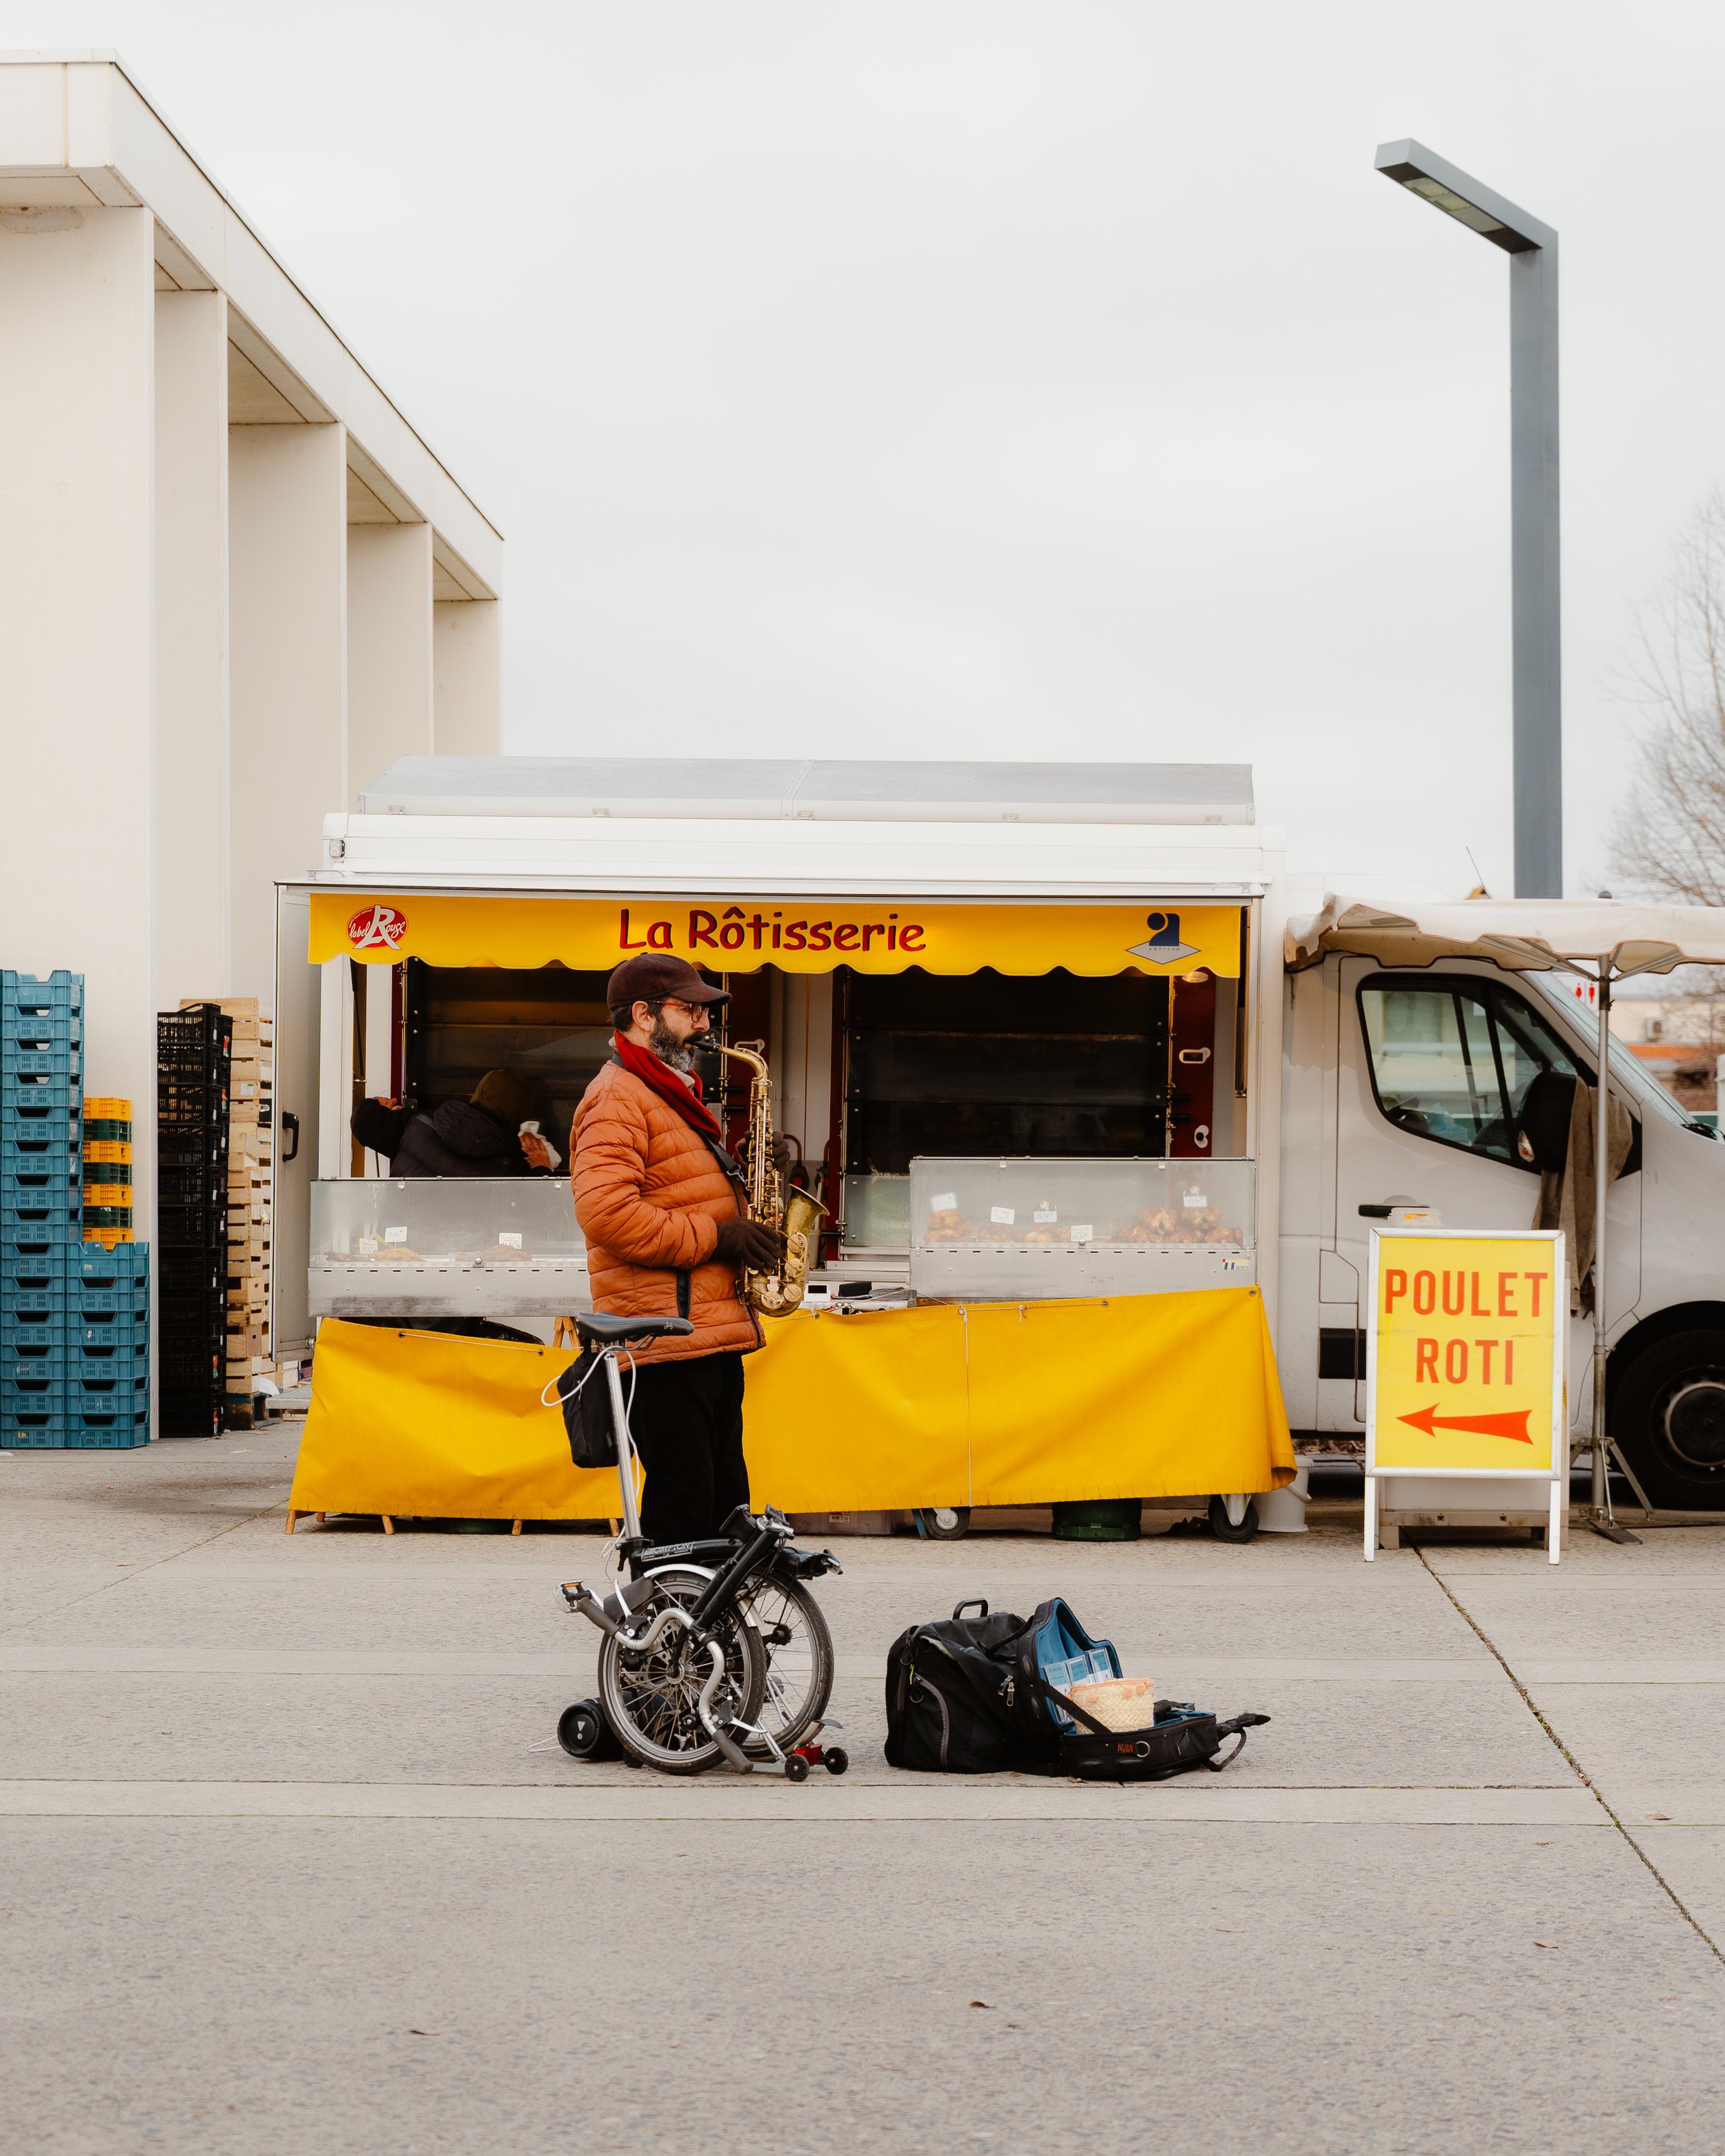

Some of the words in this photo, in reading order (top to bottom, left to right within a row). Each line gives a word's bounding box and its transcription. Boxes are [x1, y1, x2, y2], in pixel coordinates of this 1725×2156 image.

[620, 908, 672, 949] La
[689, 907, 926, 952] Rôtisserie
[1385, 1269, 1548, 1317] POULET
[1416, 1338, 1513, 1385] ROTI
[644, 1542, 691, 1555] BROMPTON
